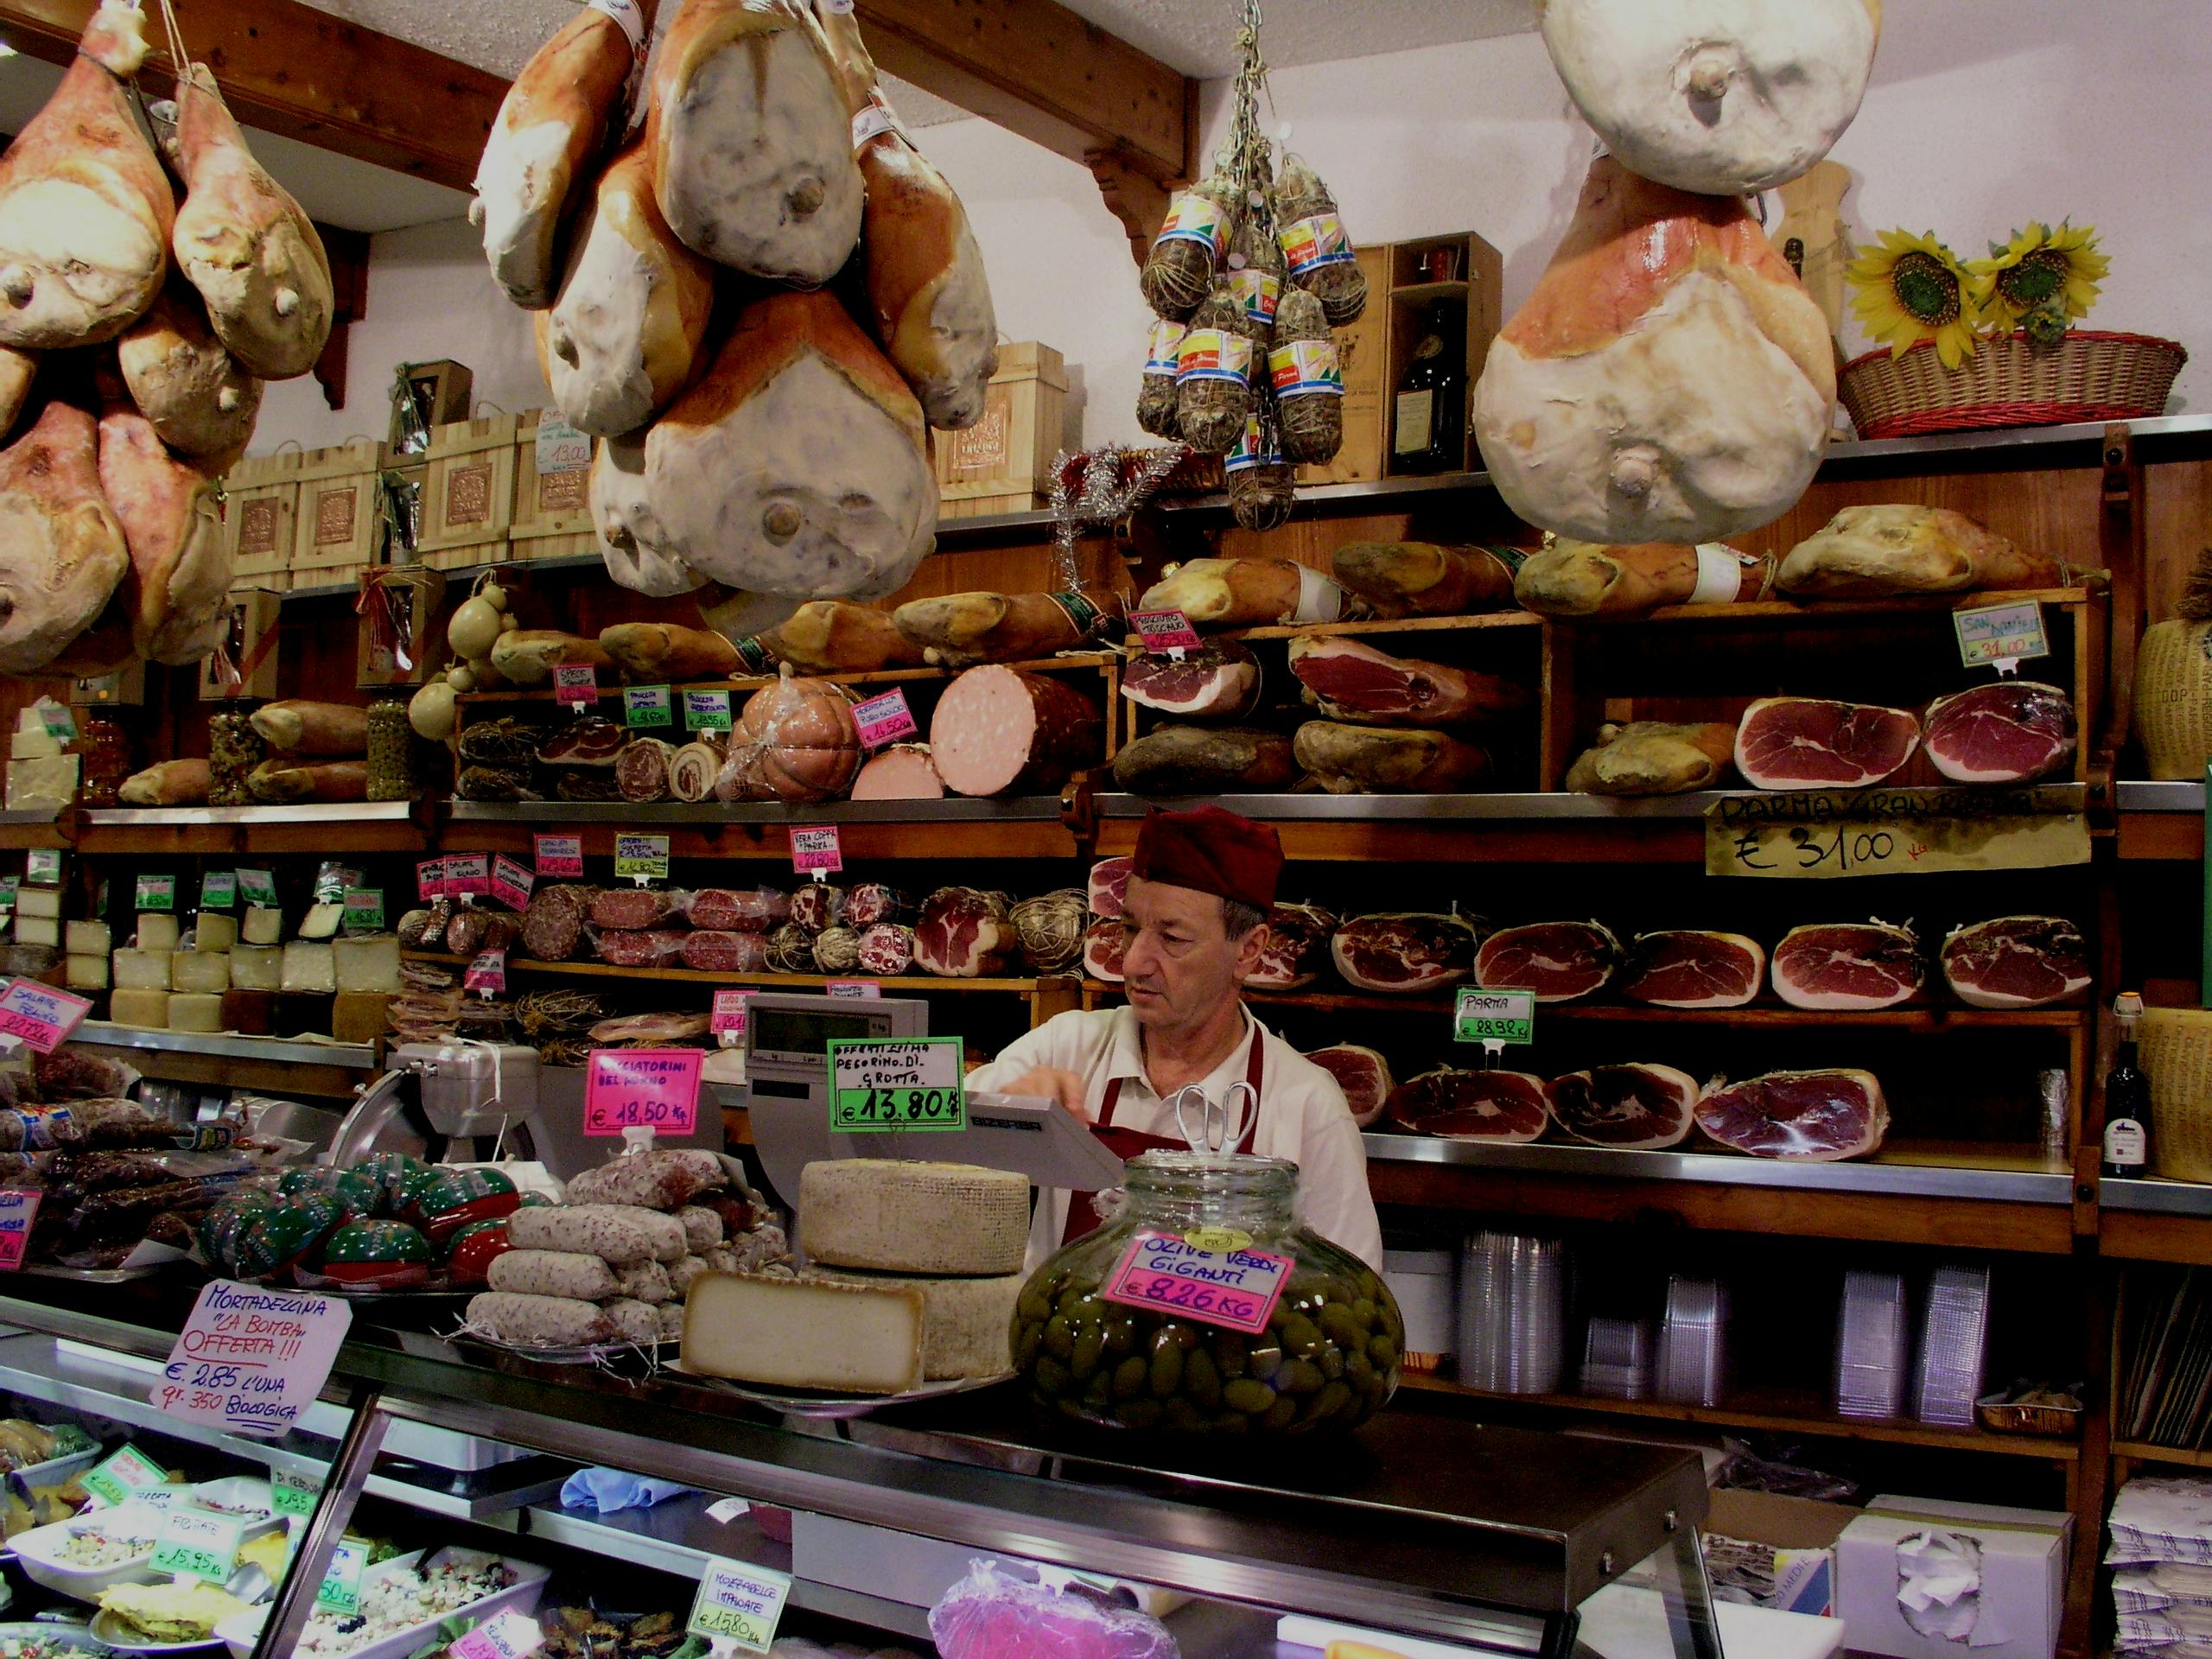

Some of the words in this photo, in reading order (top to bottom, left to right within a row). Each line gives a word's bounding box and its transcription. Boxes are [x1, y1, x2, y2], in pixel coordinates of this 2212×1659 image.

[1465, 995, 1509, 1010] PARMA
[842, 1107, 855, 1121] €
[206, 1285, 327, 1317] MORTADELLINA
[183, 1330, 276, 1356] OFFERTA
